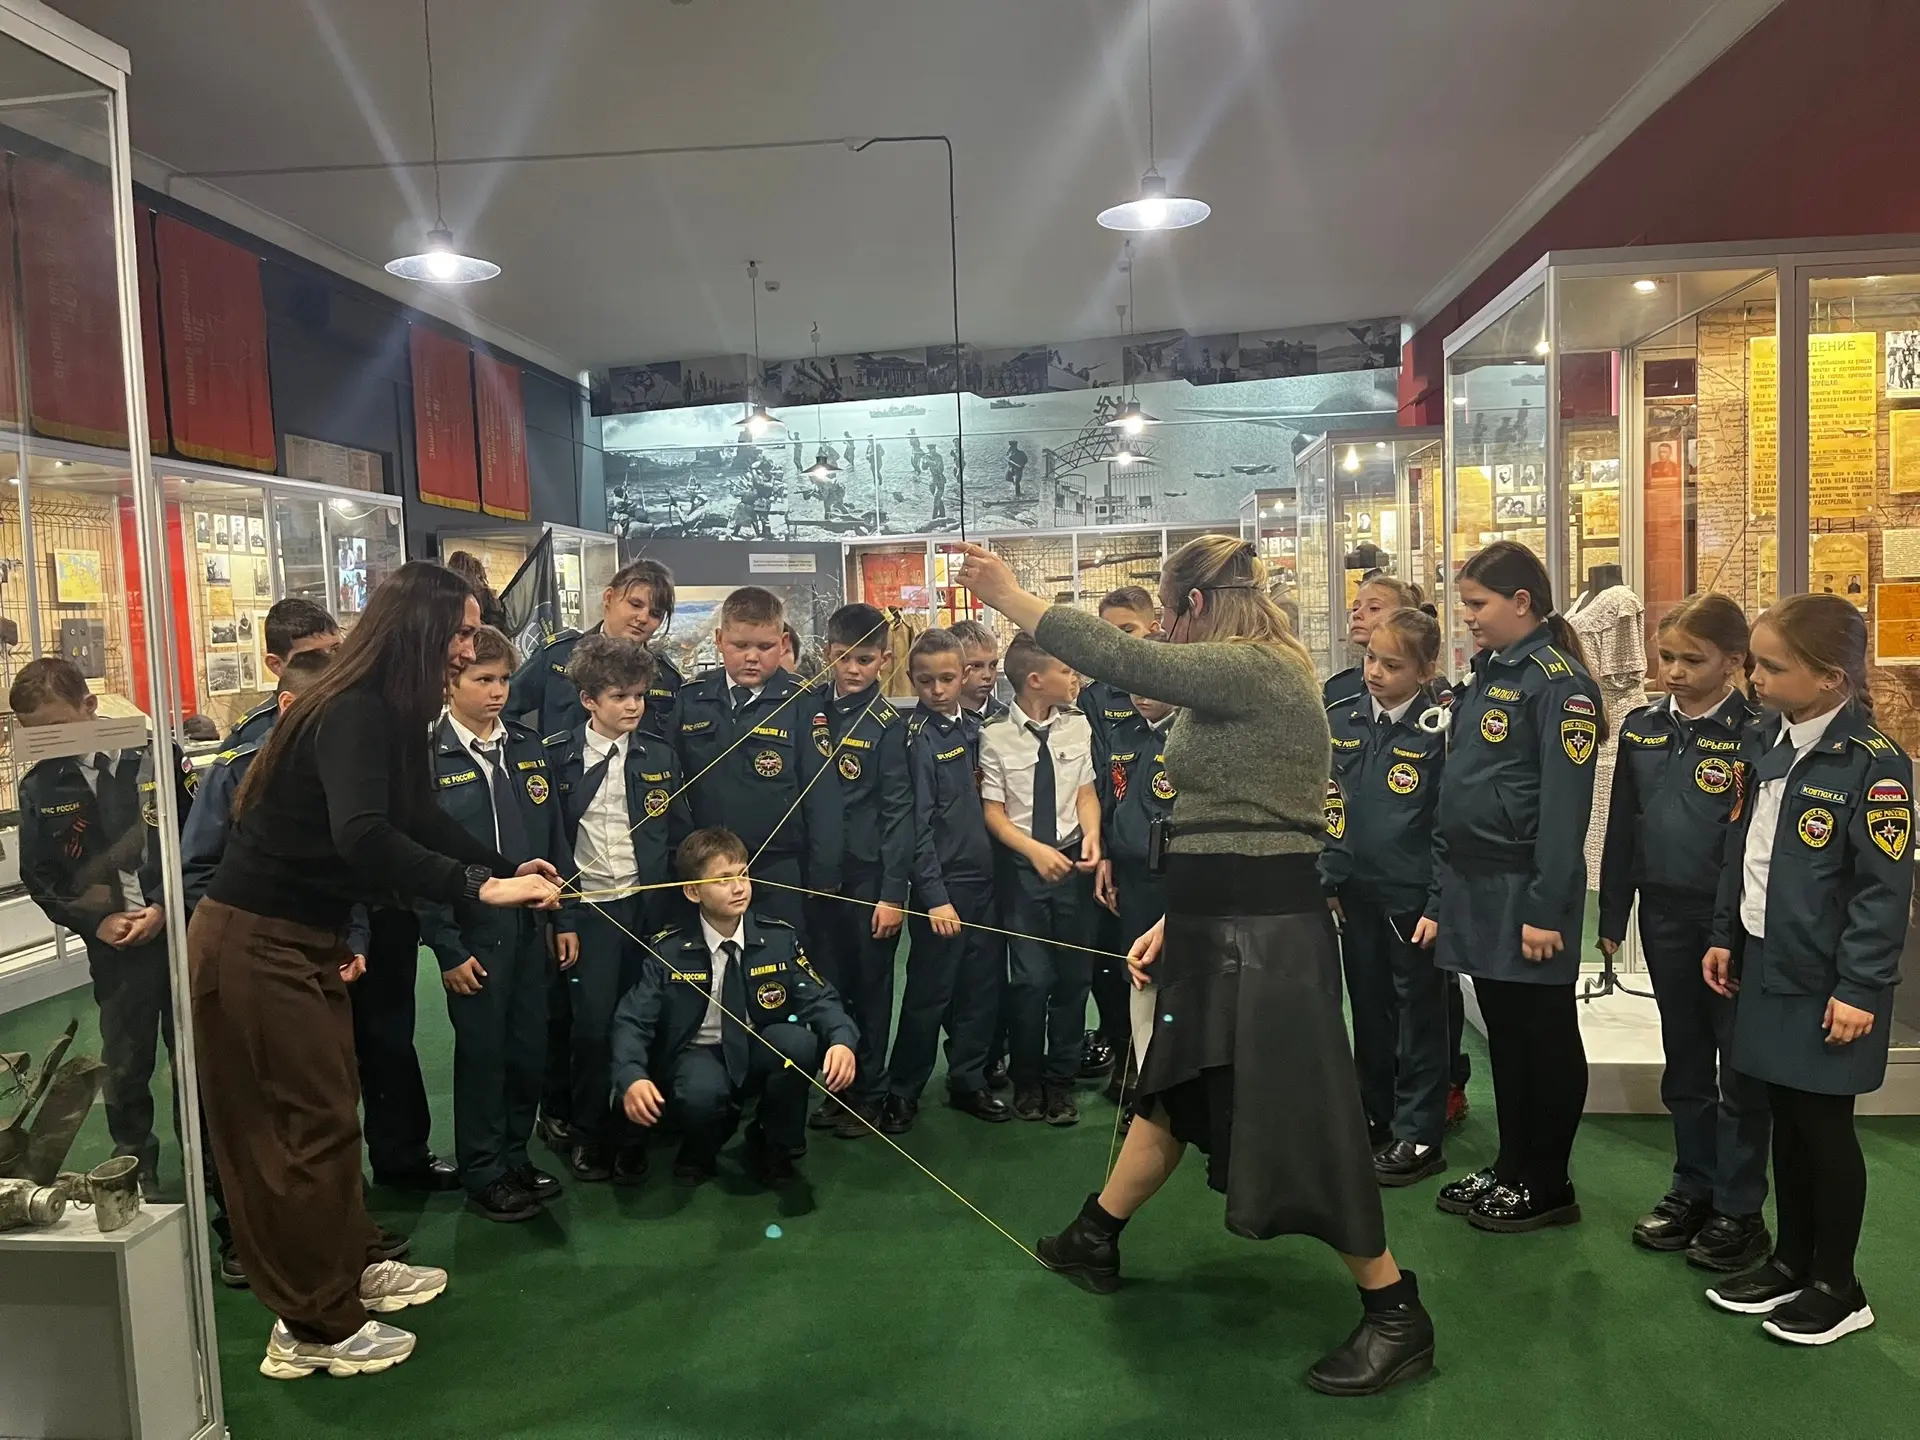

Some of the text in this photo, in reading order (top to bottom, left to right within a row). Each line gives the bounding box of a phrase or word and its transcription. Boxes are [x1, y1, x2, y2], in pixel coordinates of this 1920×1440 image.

[1549, 662, 1566, 673] ВК
[879, 708, 894, 721] ВК
[1642, 735, 1668, 745] РОССИИ
[1697, 737, 1735, 750] ЮРЬЕВА
[1867, 738, 1889, 750] ВК
[452, 771, 476, 783] РОССИИ
[56, 801, 81, 813] РОССИИ
